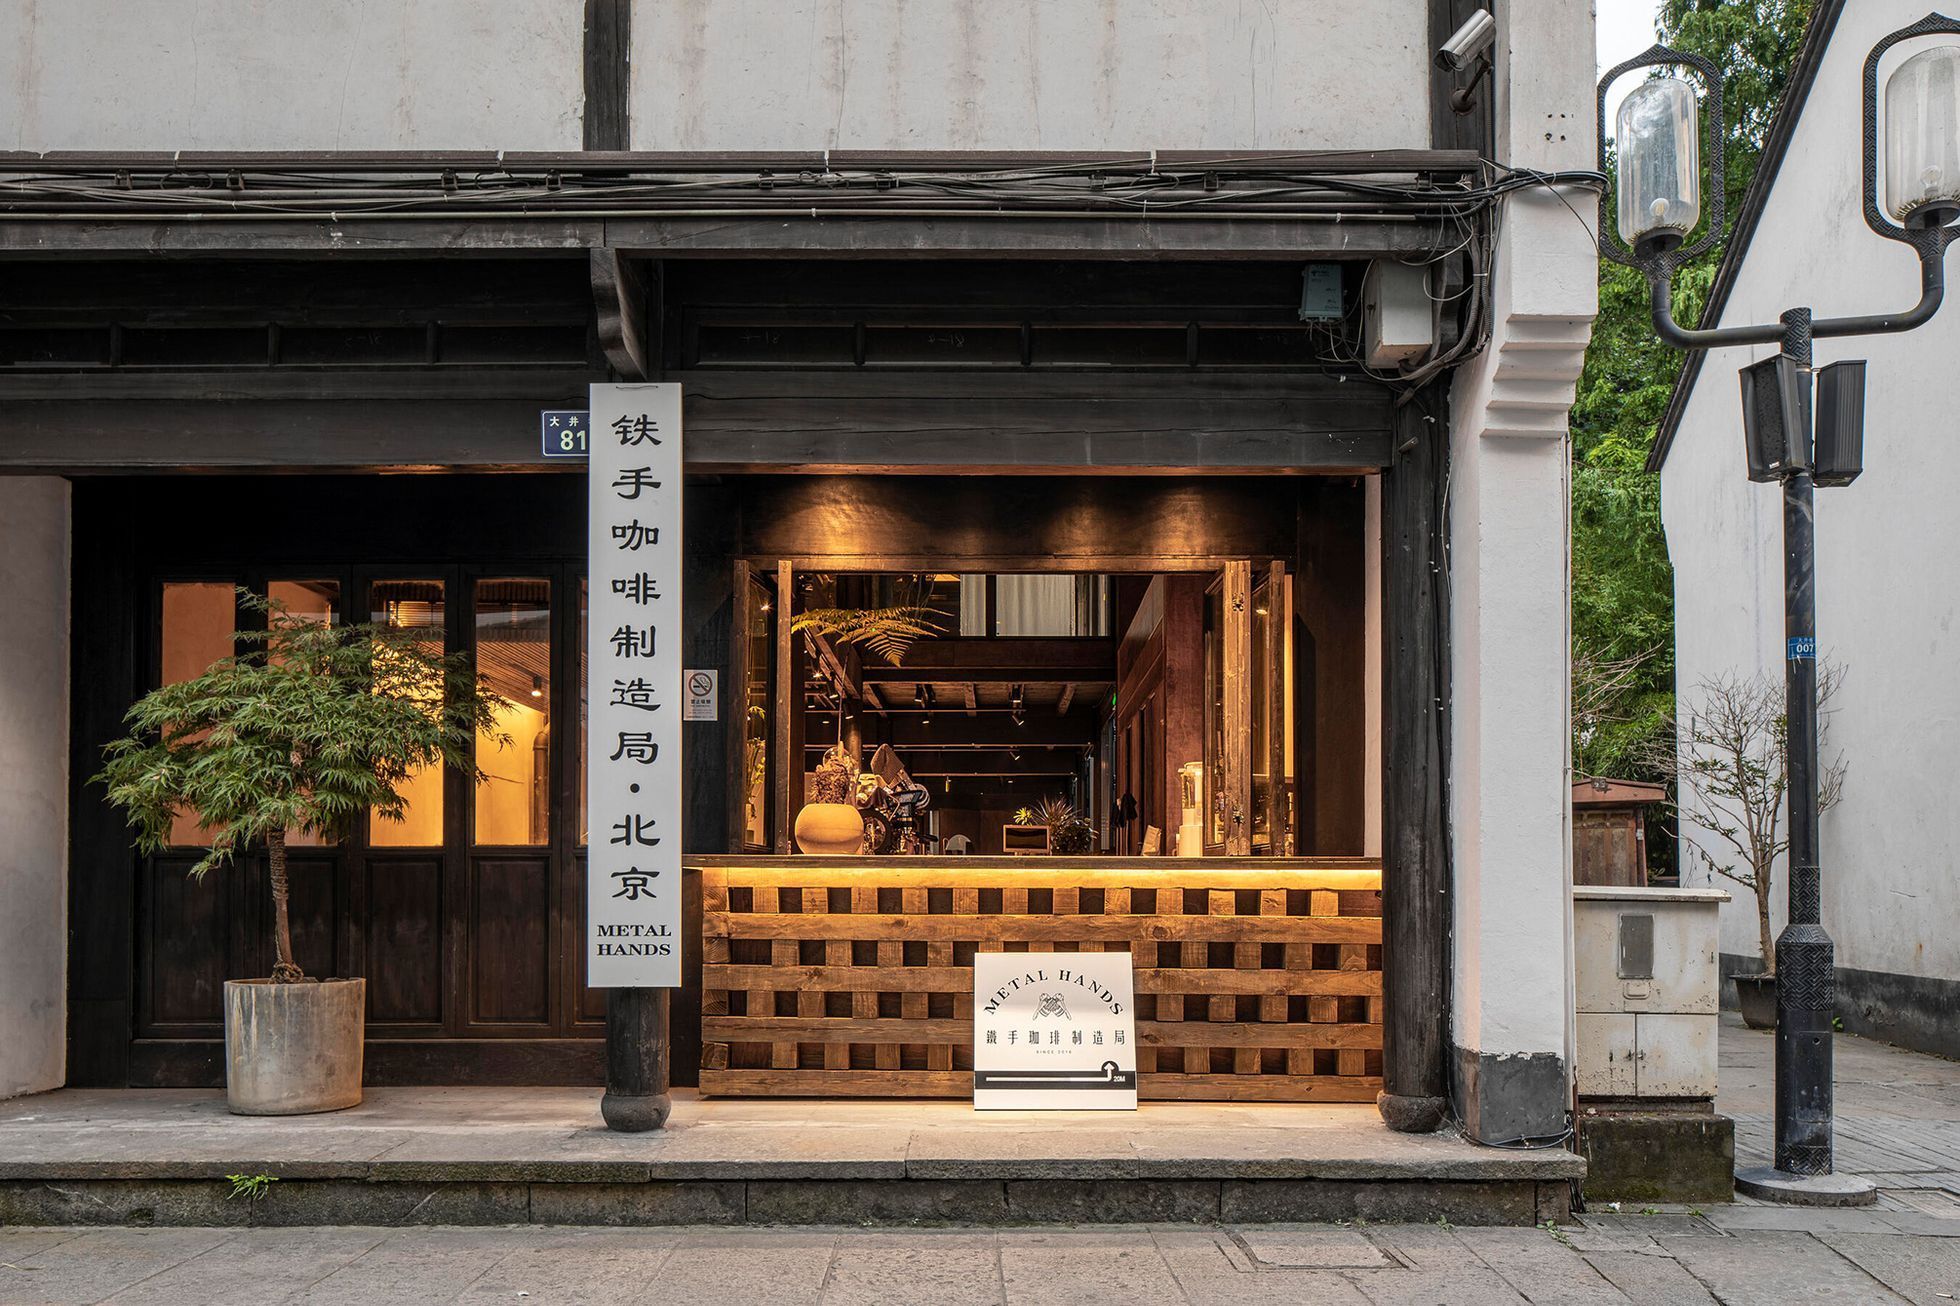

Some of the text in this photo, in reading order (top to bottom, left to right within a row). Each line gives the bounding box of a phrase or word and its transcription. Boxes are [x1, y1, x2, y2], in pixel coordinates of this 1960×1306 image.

[549, 416, 590, 427] 大井
[560, 430, 586, 450] 81
[1796, 644, 1814, 652] 007
[597, 924, 672, 937] METAL
[597, 943, 671, 956] HANDS
[983, 969, 1124, 1016] METAL HANDS
